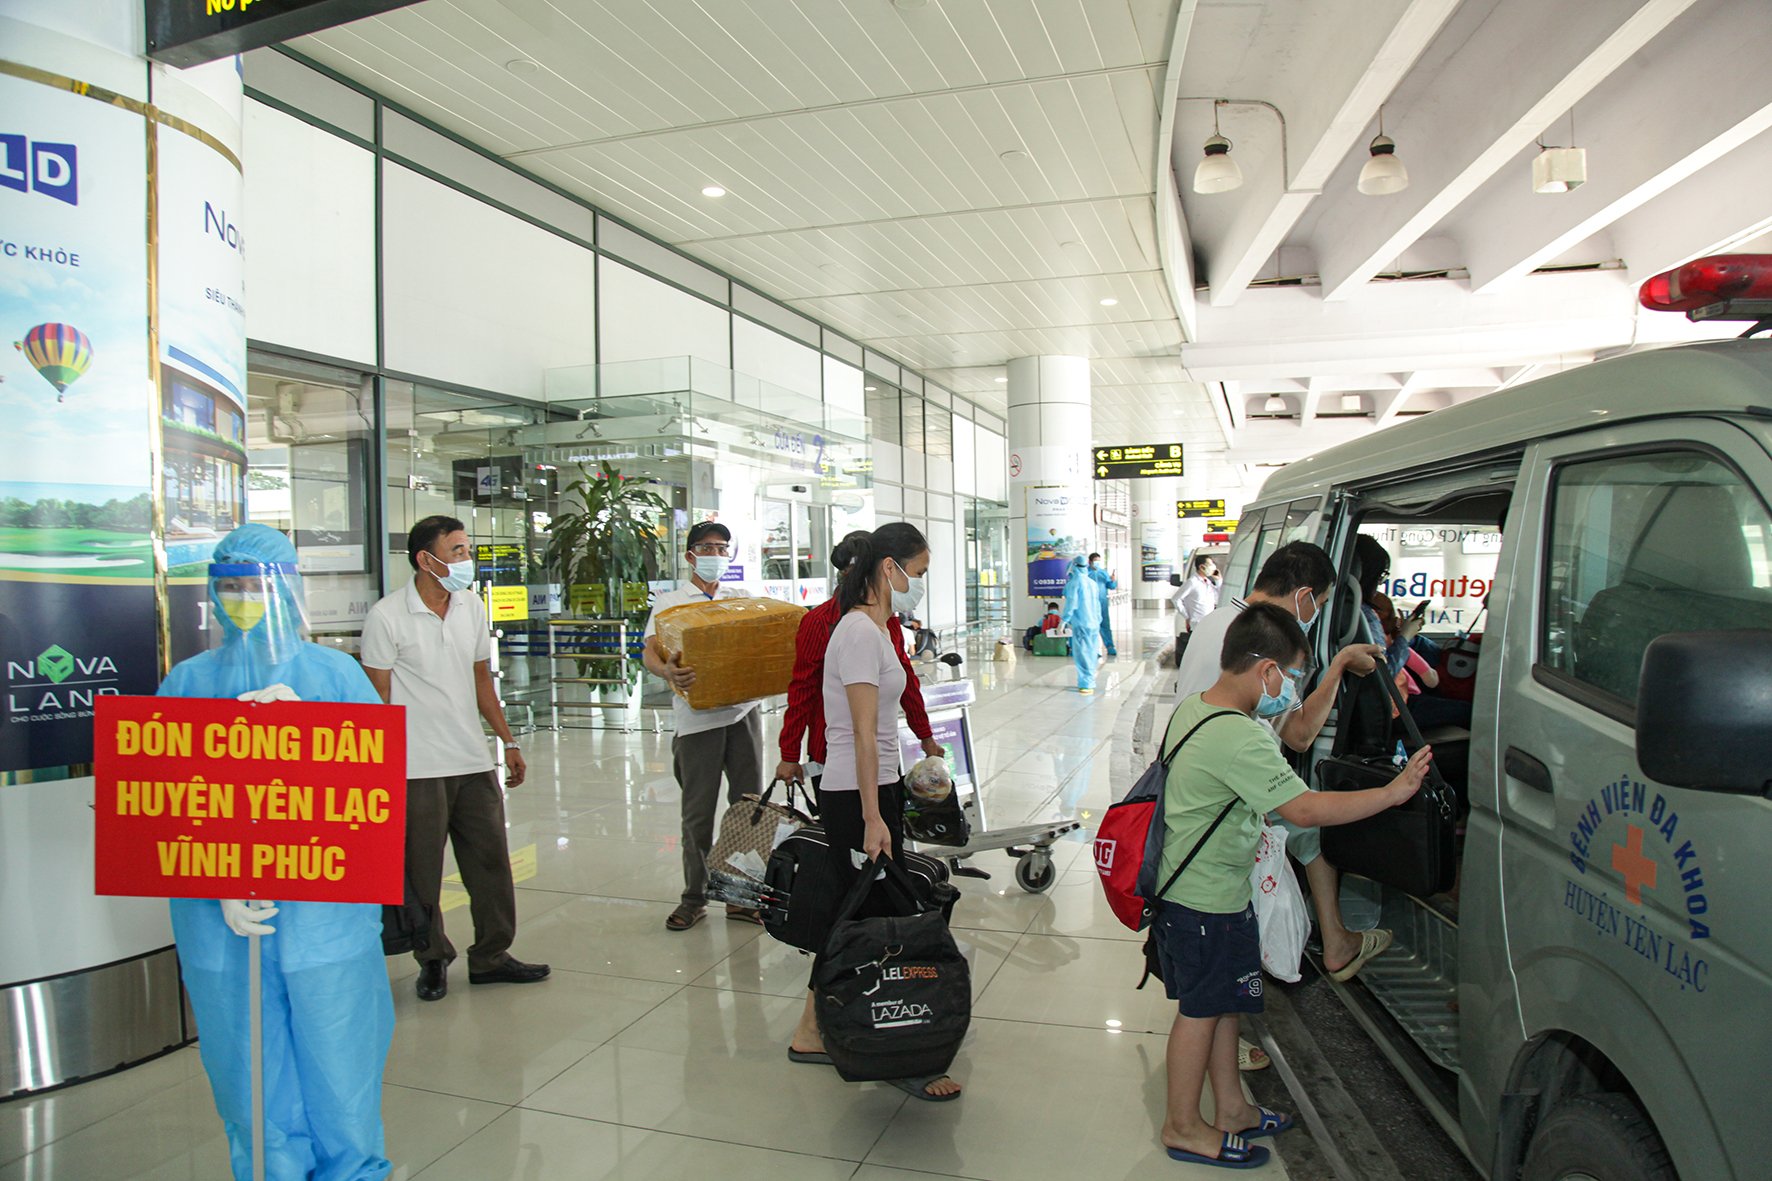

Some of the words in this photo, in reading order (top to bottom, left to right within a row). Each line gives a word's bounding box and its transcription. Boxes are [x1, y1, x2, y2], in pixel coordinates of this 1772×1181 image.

[1169, 445, 1181, 458] B
[9, 687, 119, 713] LAN
[116, 713, 192, 757] ĐÓN
[204, 716, 301, 761] CÔNG
[312, 721, 384, 764] DÂN
[116, 775, 234, 826] HUYỆN
[245, 779, 313, 821] YÊN
[324, 787, 390, 830] LẠC
[156, 835, 241, 878] VĨNH
[252, 837, 346, 881] PHÚC
[1569, 799, 1602, 874] BỆNH
[1601, 774, 1646, 817] VIỆN
[1649, 793, 1678, 843] ĐA
[1673, 840, 1711, 940] KHOA
[1564, 881, 1621, 936] HUYỆN
[1624, 915, 1662, 964] YÊN
[1664, 940, 1709, 993] LẠC
[1249, 978, 1262, 997] 9
[871, 1004, 933, 1022] LAZADA
